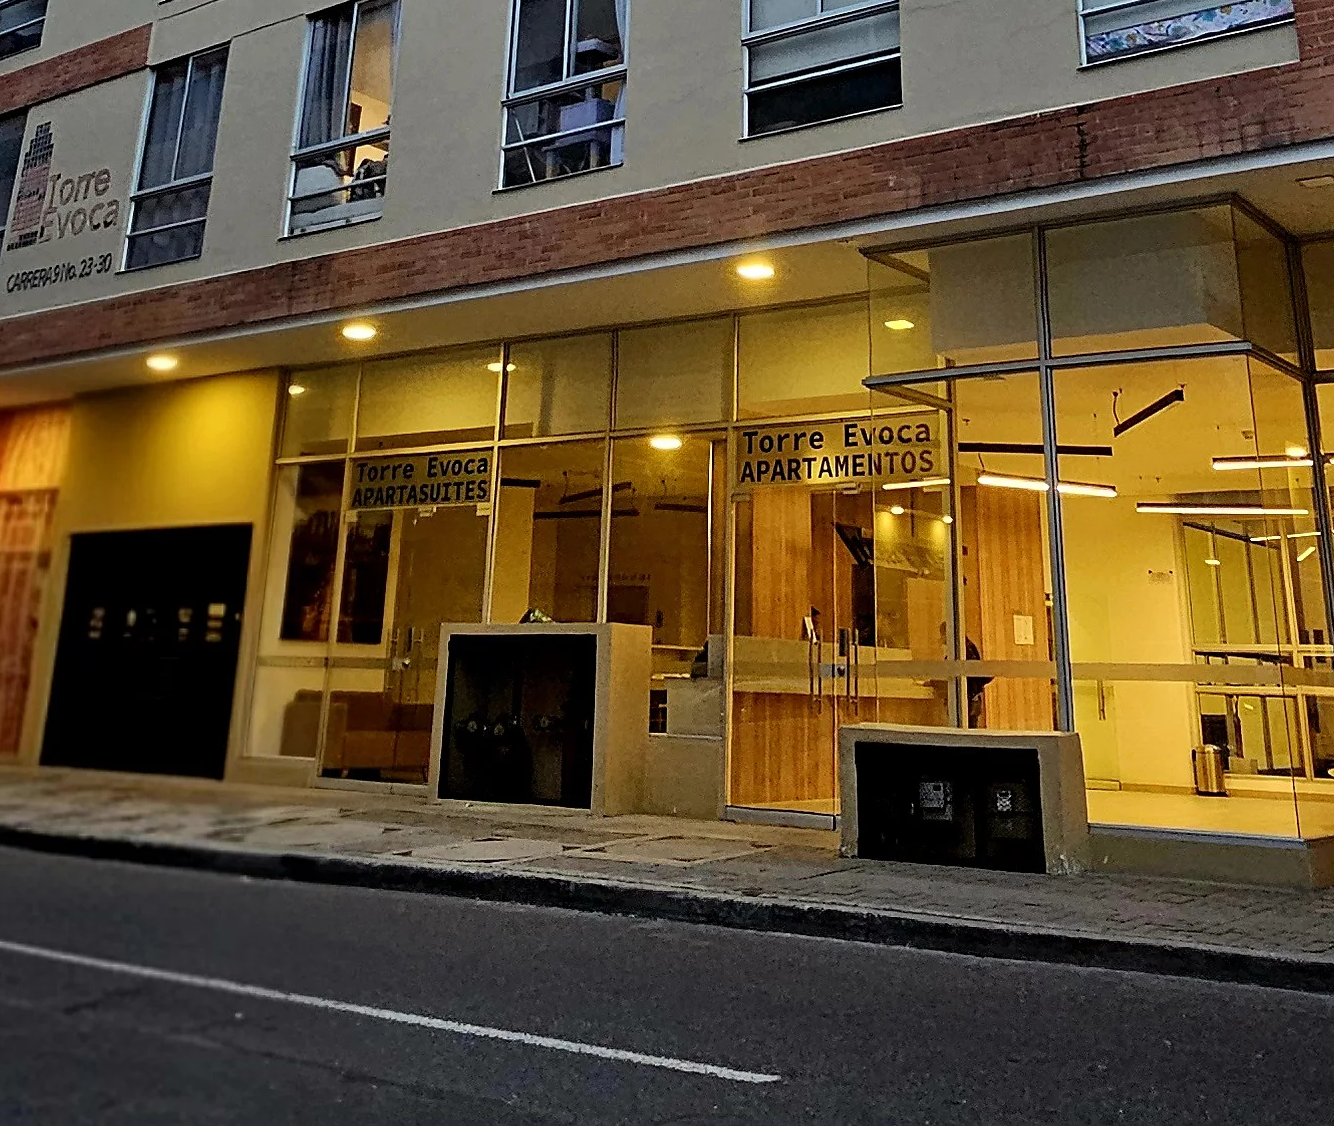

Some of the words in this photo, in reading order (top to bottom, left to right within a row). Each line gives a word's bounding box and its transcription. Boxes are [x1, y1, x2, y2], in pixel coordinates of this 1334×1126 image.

[46, 168, 111, 209] Torre
[38, 199, 120, 244] Evoca
[7, 267, 52, 293] CARRERA
[79, 252, 113, 278] 23-30
[742, 430, 825, 455] Torre
[844, 423, 932, 448] Evoca
[356, 462, 415, 483] Torre
[427, 457, 488, 478] Evoca
[740, 449, 935, 483] APARTAMENTOS
[351, 479, 488, 507] APARTASUITES
